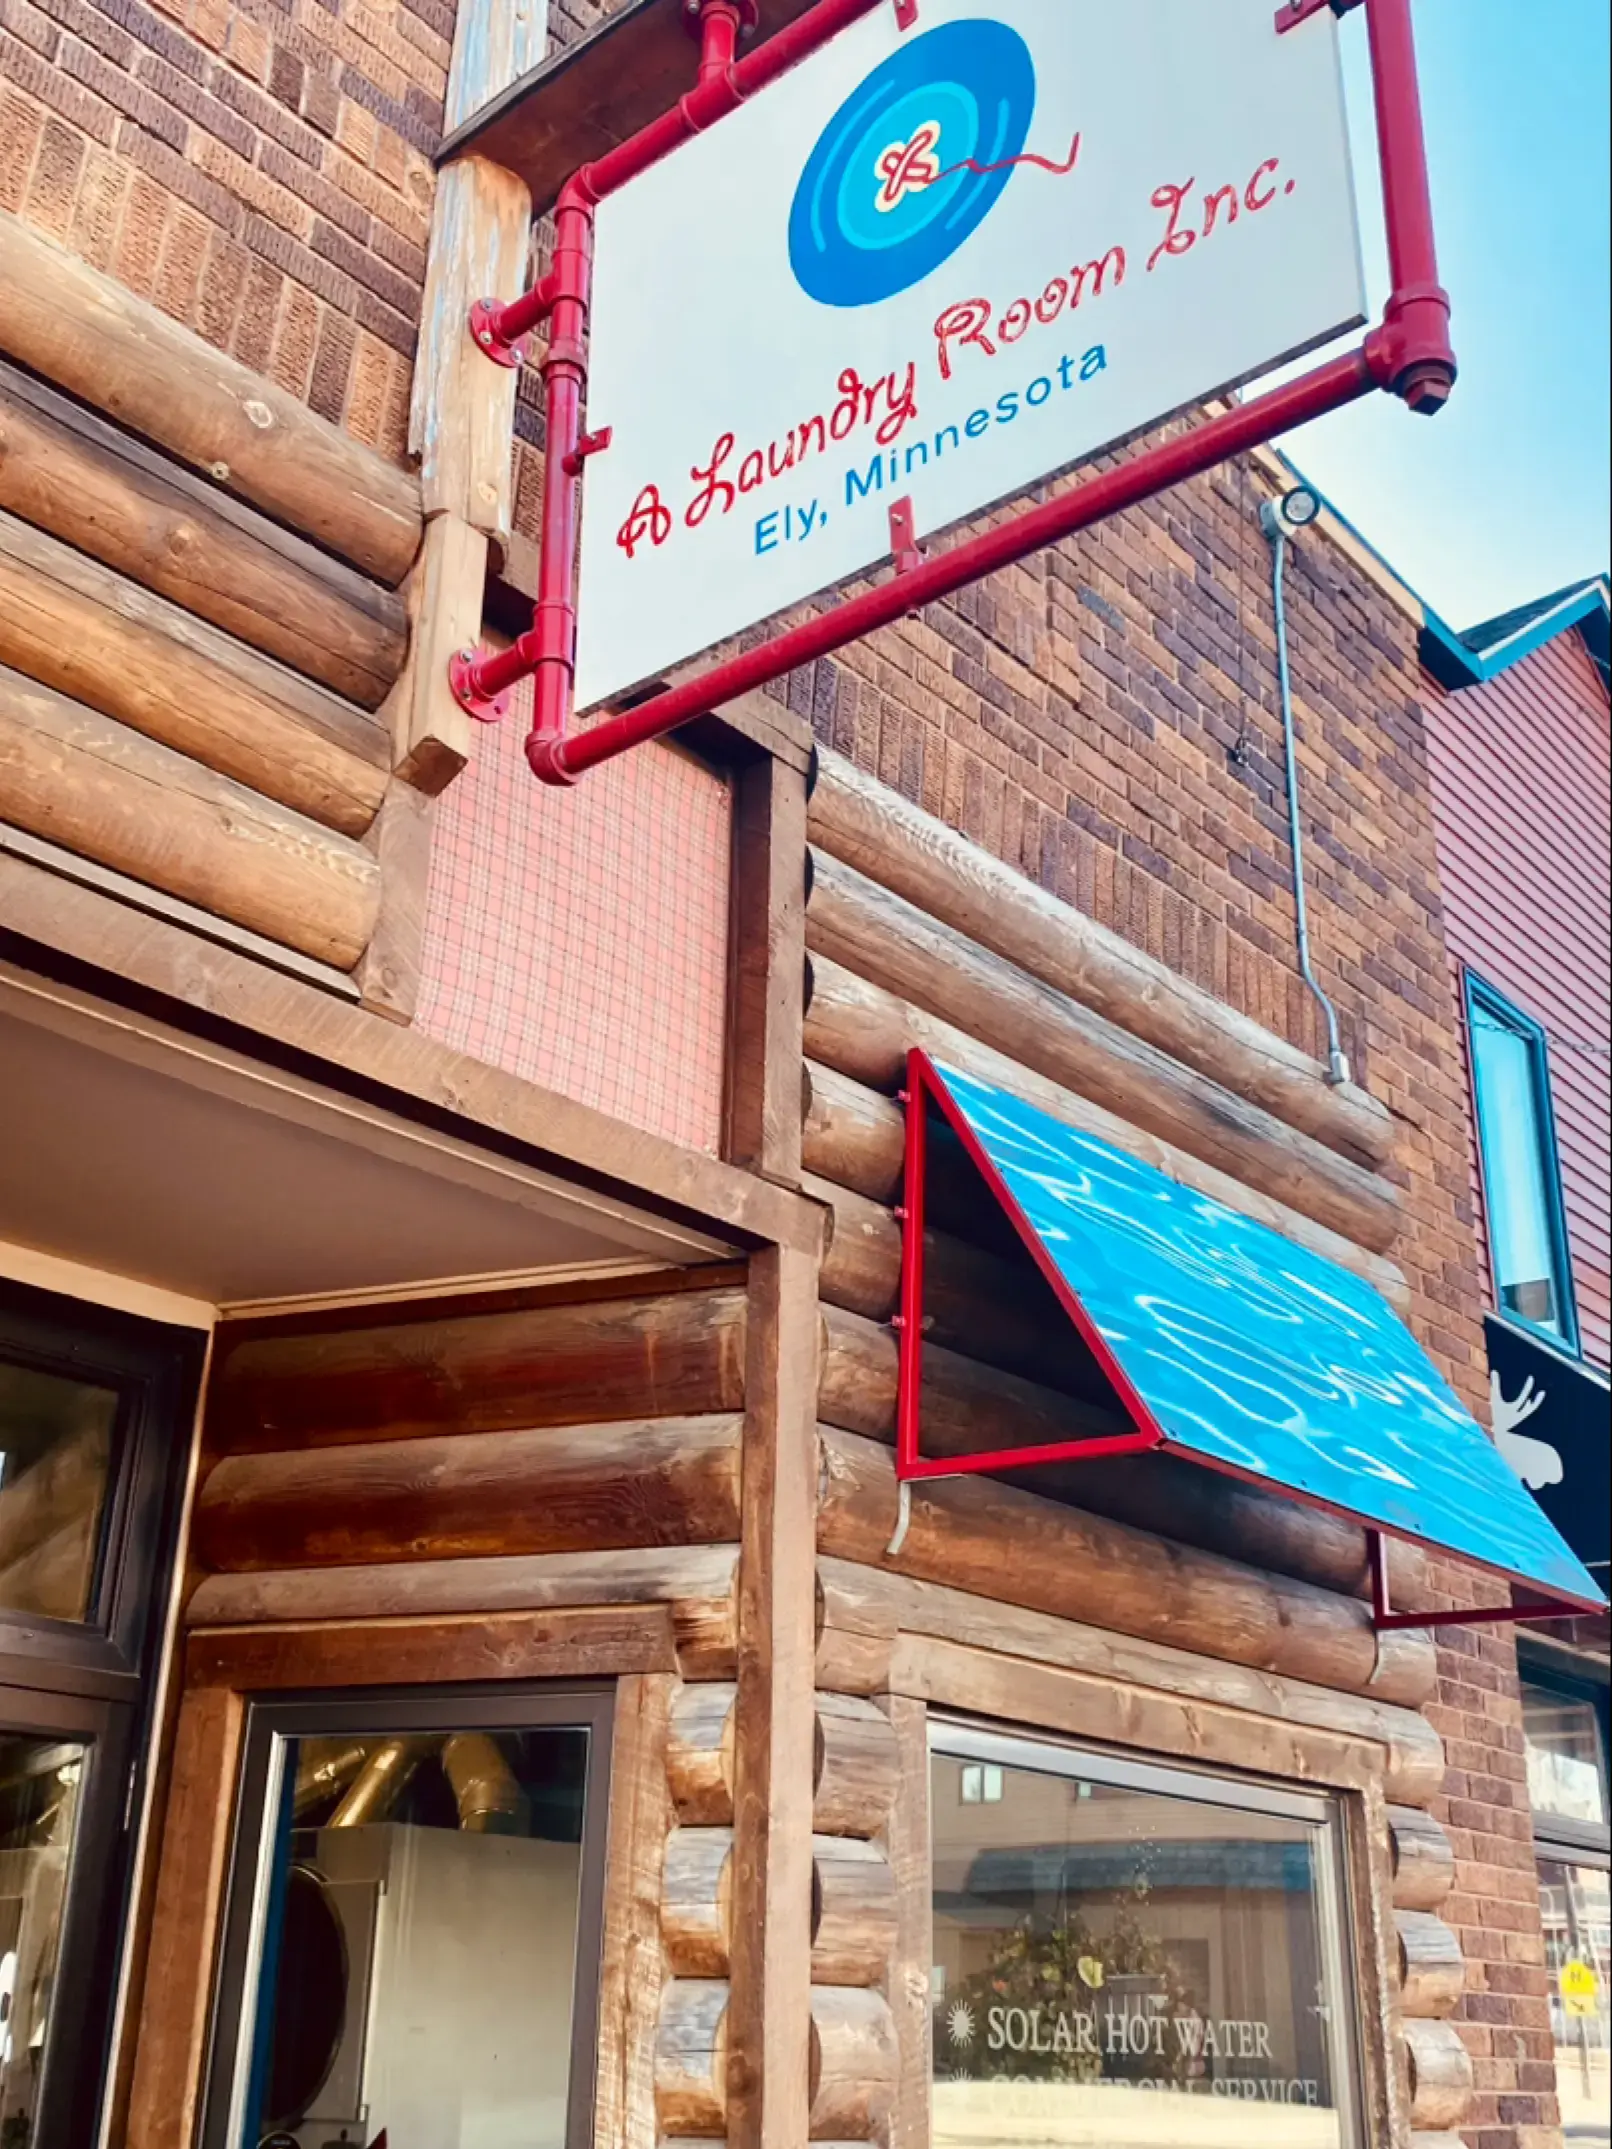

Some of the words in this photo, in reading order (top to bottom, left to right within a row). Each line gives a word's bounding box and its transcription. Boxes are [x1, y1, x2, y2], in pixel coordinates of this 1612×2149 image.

[616, 484, 672, 558] A
[685, 363, 917, 528] Laundry
[934, 247, 1126, 380] Room
[1147, 157, 1296, 271] Inc.
[755, 501, 827, 556] Ely,
[846, 344, 1108, 507] Minnesota
[986, 2006, 1097, 2053] SOLAR
[1105, 2013, 1170, 2056] HOT
[1176, 2017, 1273, 2060] WATER
